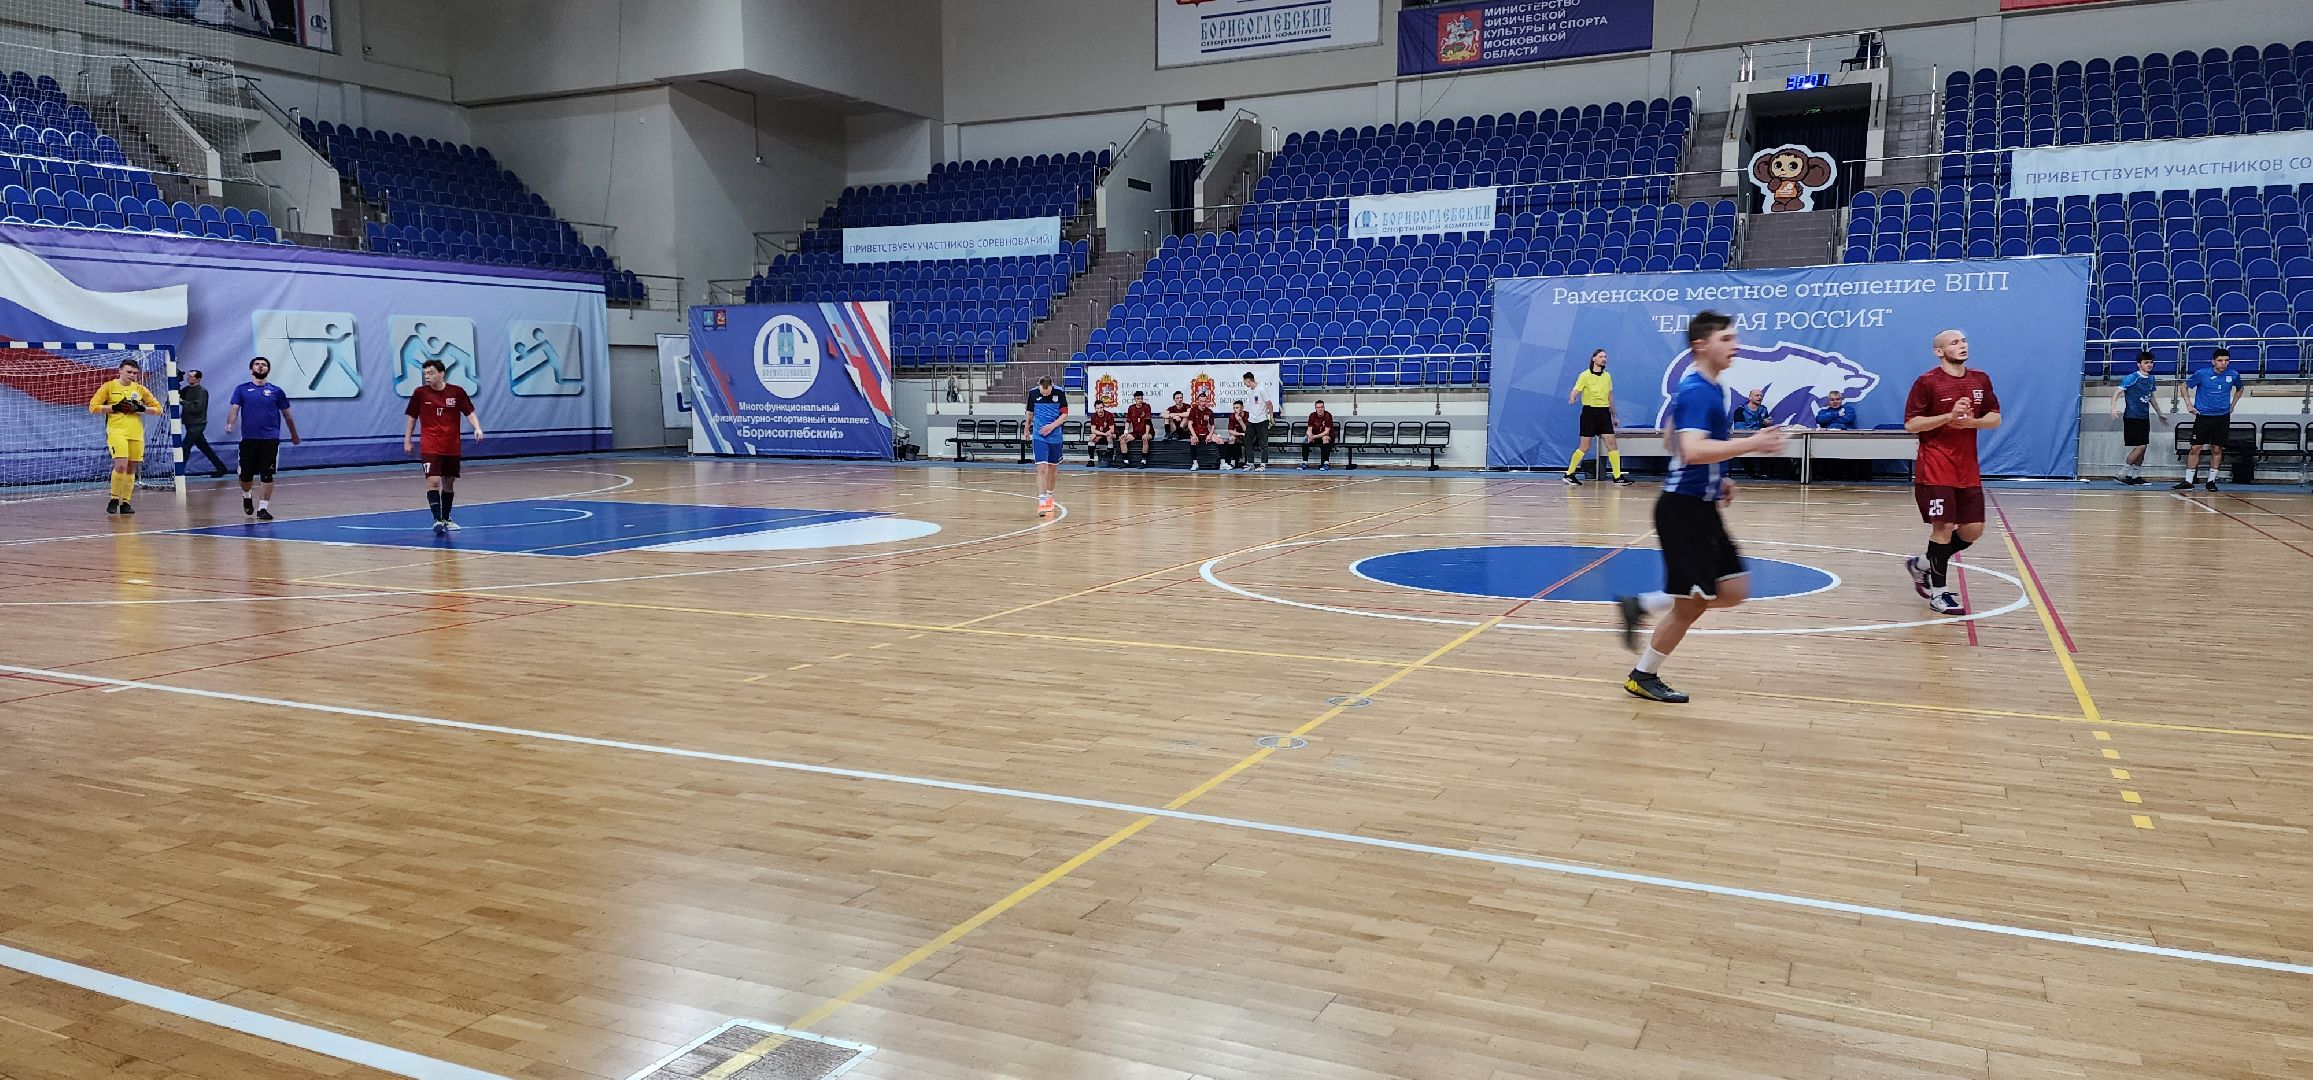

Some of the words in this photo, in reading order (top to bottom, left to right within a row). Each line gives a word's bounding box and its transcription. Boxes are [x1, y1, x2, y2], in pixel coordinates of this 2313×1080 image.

[1484, 0, 1581, 17] МИНИСТЕРСТВО
[1201, 6, 1332, 40] БОРИСОГЛЕБСКИЙ
[1484, 10, 1566, 28] ФИЗИЧЕСКОЙ
[1484, 24, 1545, 39] КУЛЬТУРЫ
[1548, 22, 1557, 31] И
[1560, 16, 1608, 30] СПОРТА
[1201, 33, 1272, 47] спортивный
[1275, 26, 1332, 39] комплекс
[1484, 31, 1566, 48] МОСКОВСКОЙ
[1483, 46, 1538, 59] ОБЛАСТИ
[2026, 166, 2159, 185] ПРИВЕТСТВУЕМ
[2164, 158, 2283, 177] УЧАСТНИКОВ
[1382, 223, 1440, 233] спортивный
[850, 242, 915, 254] ПРИВЕТСТВУЕМ
[918, 239, 975, 251] УЧАСТНИКОВ
[977, 233, 1053, 248] СОРЕВНОВАНИЙ!
[1553, 287, 1679, 305] Раменское
[1685, 284, 1788, 301] местное
[1795, 278, 1937, 298] отделение
[1944, 271, 2010, 292] ВПП
[1651, 311, 1767, 334] "ЕДАЯ
[1774, 308, 1893, 330] РОССИЯ"
[436, 407, 444, 416] 17
[738, 401, 840, 413] Многофункциональный
[713, 413, 825, 424] физкультурно-спортивный
[827, 415, 870, 424] комплекс
[737, 425, 844, 440] «Борисоглебский»
[423, 462, 431, 473] 17
[1928, 498, 1945, 517] 25
